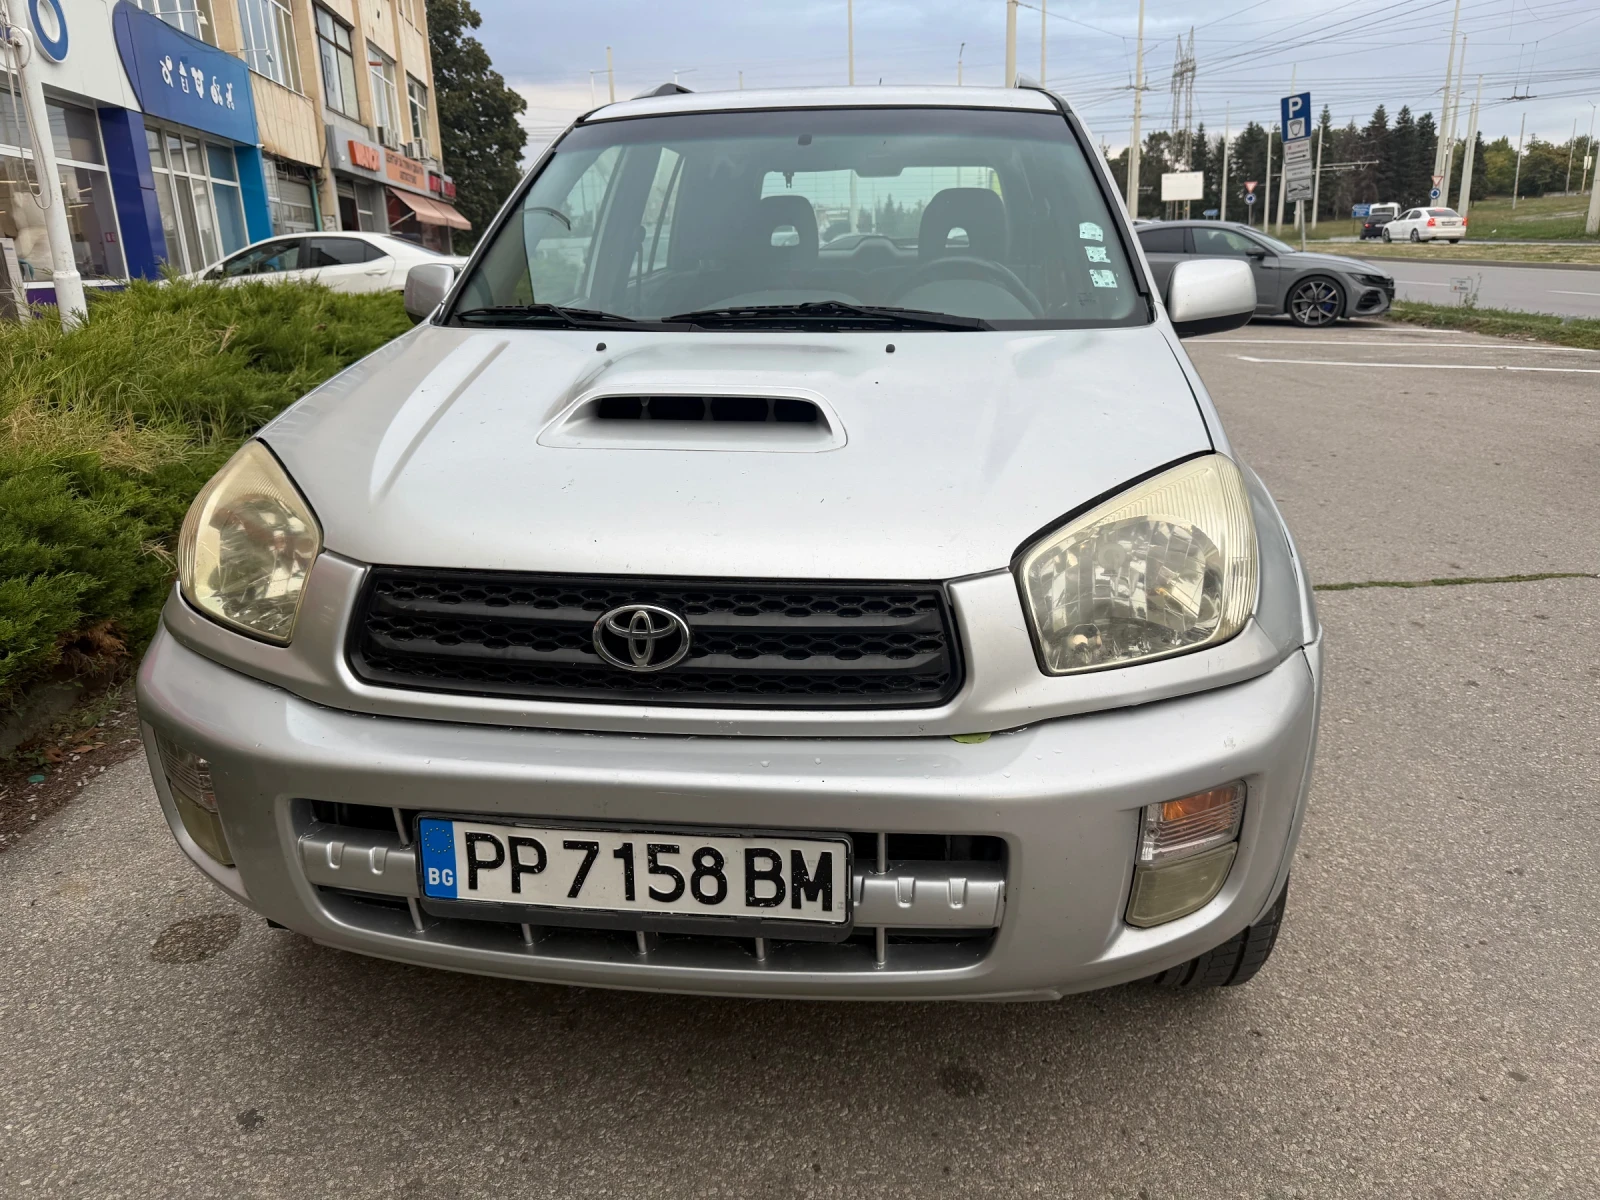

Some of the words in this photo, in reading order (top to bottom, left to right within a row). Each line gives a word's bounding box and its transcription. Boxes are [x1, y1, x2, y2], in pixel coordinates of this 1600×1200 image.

[1288, 96, 1303, 119] P
[428, 867, 454, 886] BG
[465, 831, 547, 893] PP
[563, 839, 728, 905] 7158
[744, 847, 833, 912] BM
